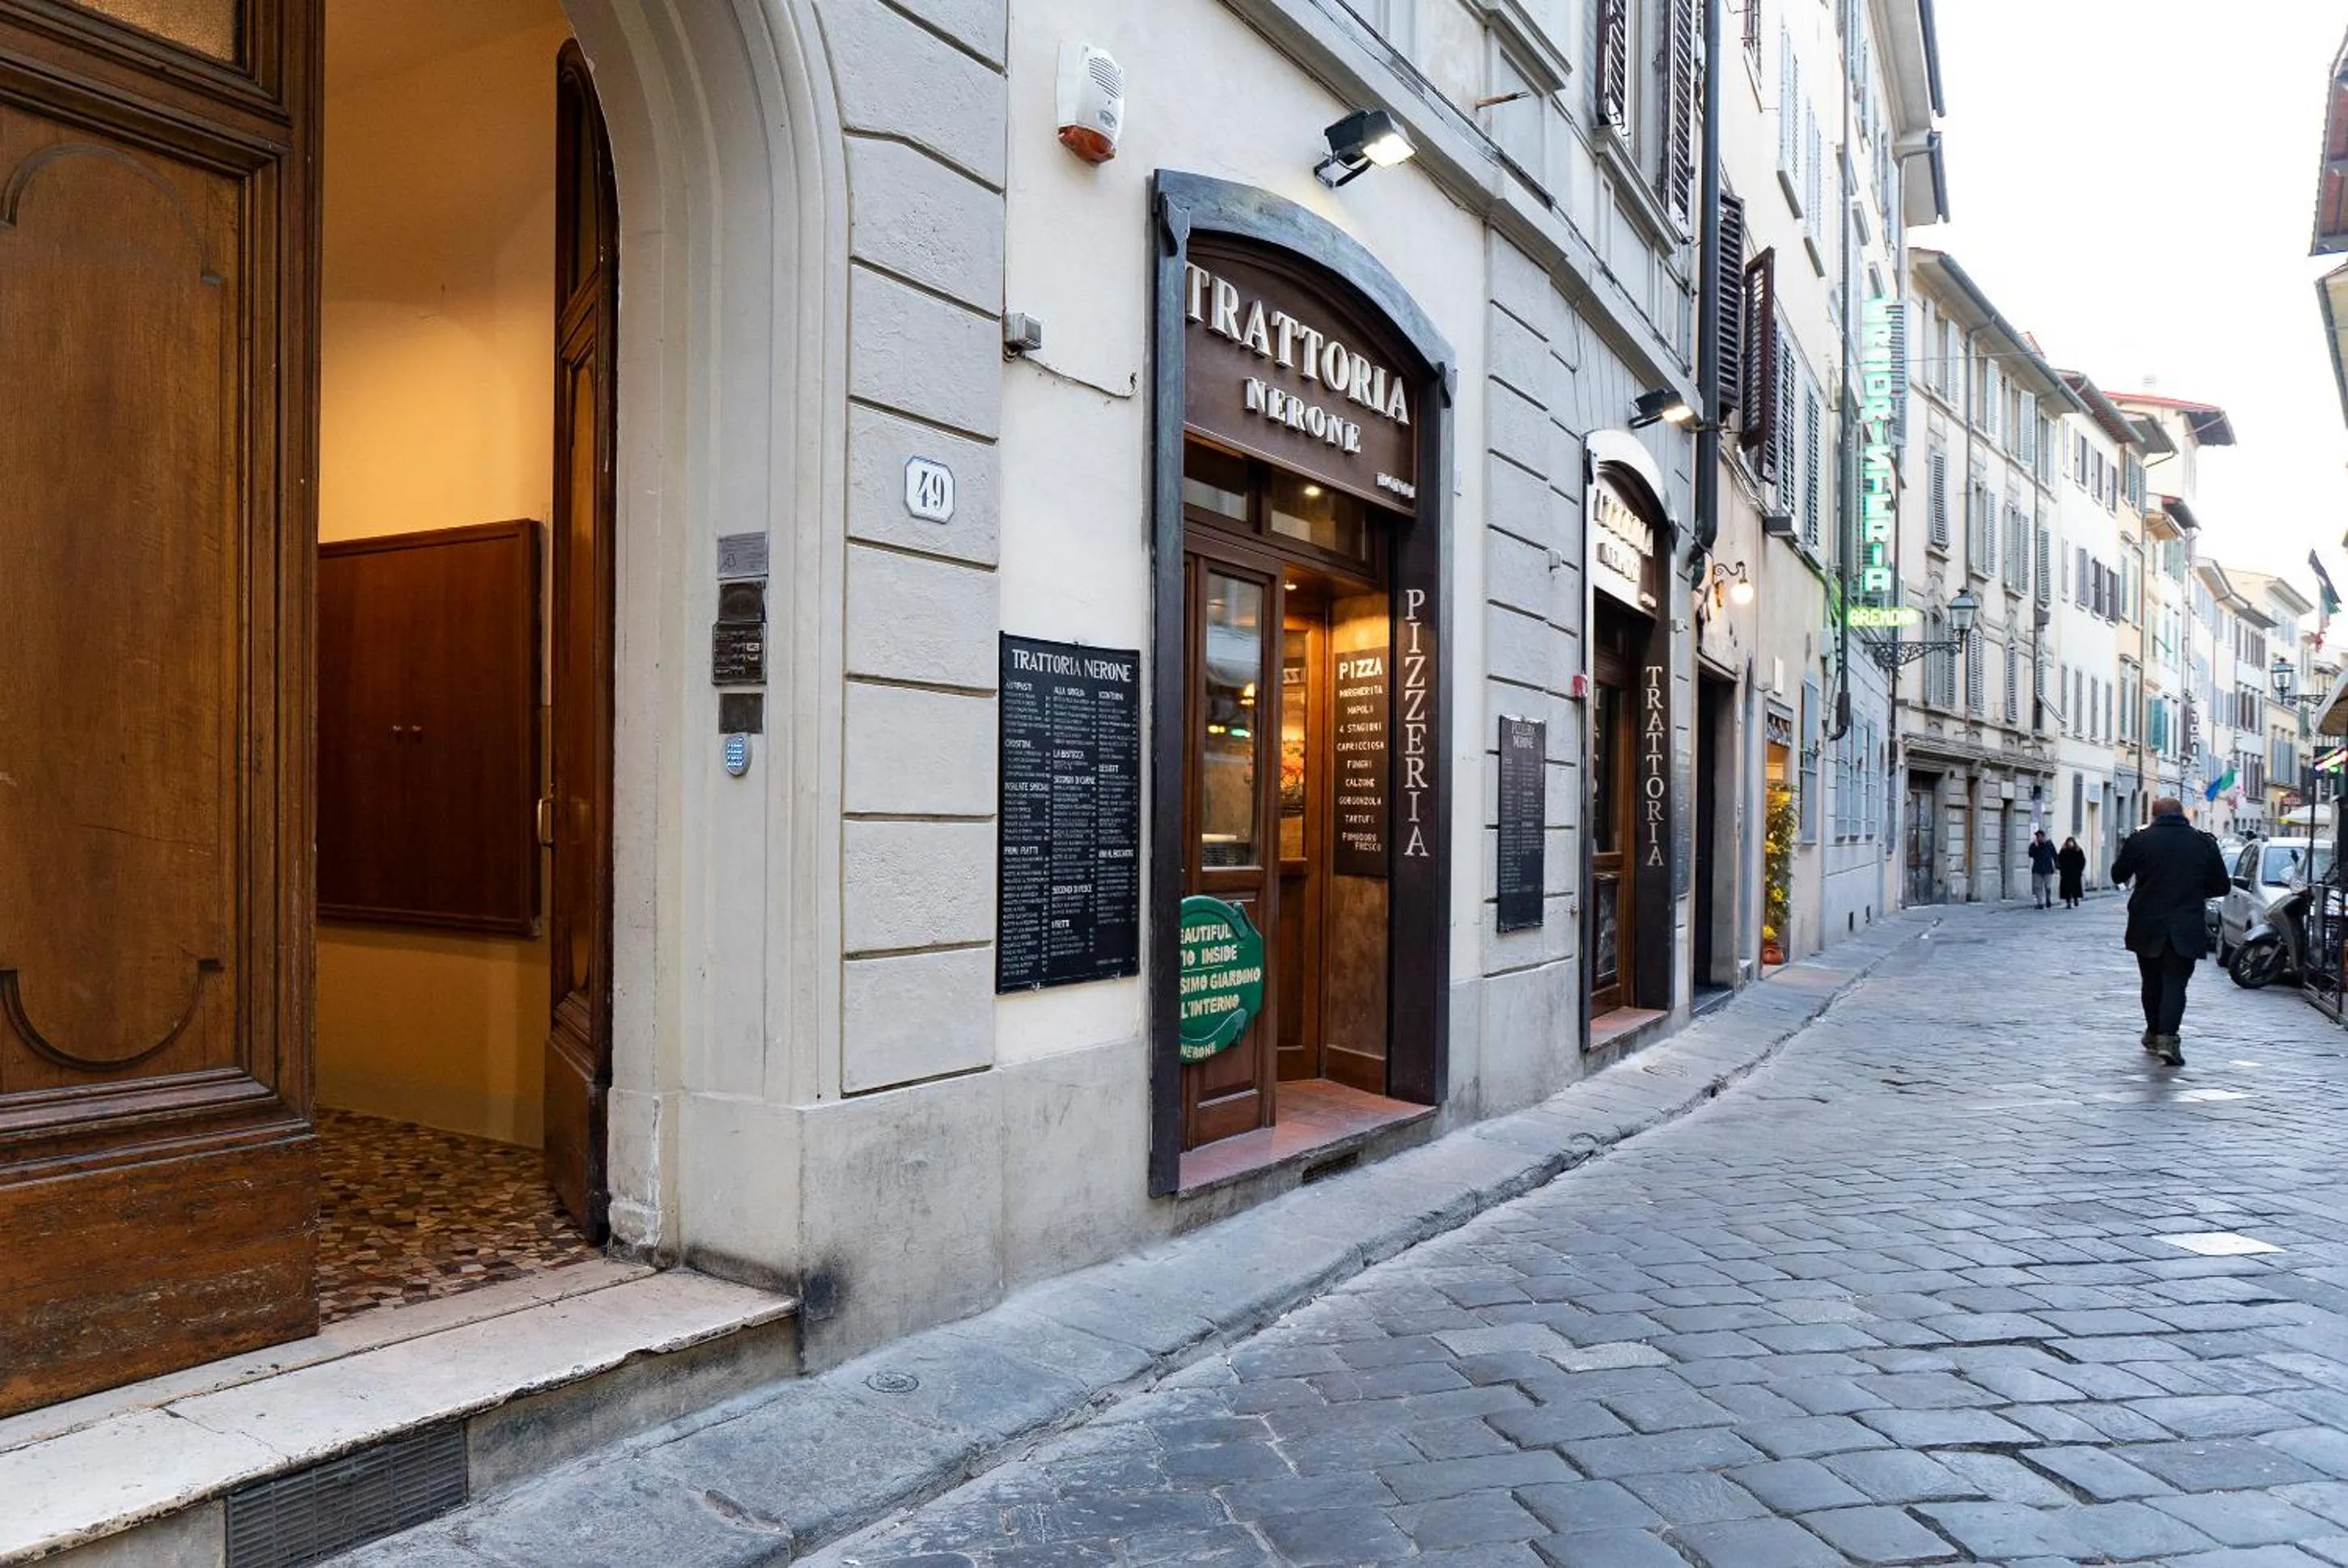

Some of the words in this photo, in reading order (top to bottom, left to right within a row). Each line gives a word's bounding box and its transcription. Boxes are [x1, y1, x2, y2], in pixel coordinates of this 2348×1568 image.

[1185, 261, 1410, 426] TRATTORIA
[1243, 376, 1362, 454] NERONE
[916, 470, 945, 511] 49
[1012, 648, 1082, 678] TRATTORIA
[1084, 658, 1133, 683] NERONE
[1339, 657, 1383, 680] PIZZA
[1339, 684, 1383, 699] MARGHERITA
[1347, 704, 1374, 715] NAPOLI
[1339, 725, 1345, 733] 4
[1347, 721, 1382, 733] STAGIONI
[1403, 589, 1429, 857] PIZZERIA
[1337, 741, 1385, 752] CAPRICCIOSA
[1347, 760, 1372, 769] FUNGHI
[1646, 665, 1665, 866] TRATTORIA
[1345, 778, 1376, 788] CALZONE
[1338, 796, 1381, 805] GORGONZOLA
[1180, 923, 1231, 945] EAUTIFUL
[1202, 945, 1237, 964] INSIDE
[1180, 975, 1207, 995] SIMO
[1210, 967, 1261, 989] GIARDINO
[1181, 994, 1240, 1019] L'INTERNO
